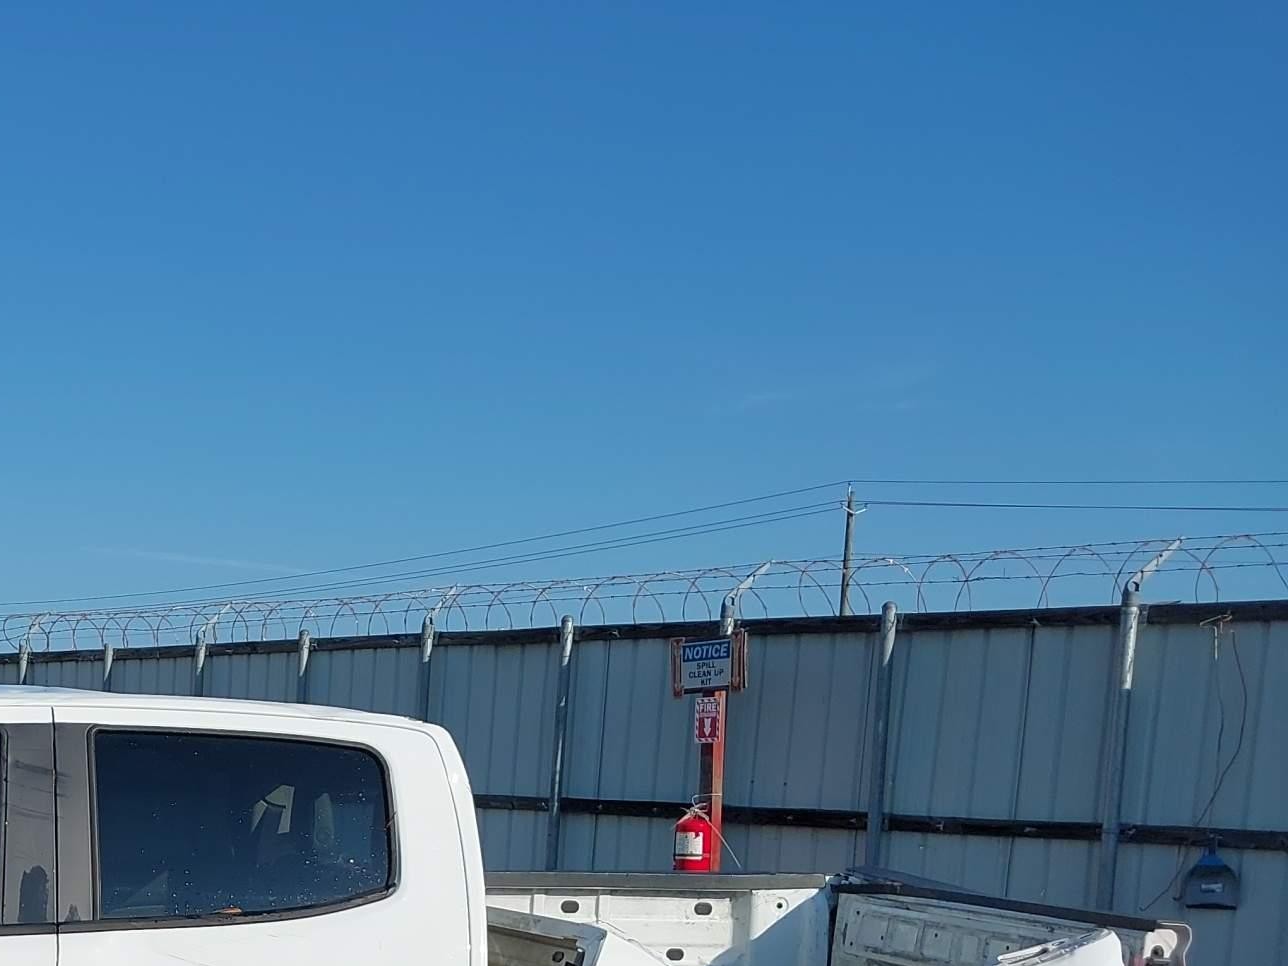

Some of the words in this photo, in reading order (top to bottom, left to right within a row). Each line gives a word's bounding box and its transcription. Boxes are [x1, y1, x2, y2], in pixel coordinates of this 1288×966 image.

[685, 644, 728, 660] NOTICE
[696, 662, 716, 670] SPILL
[689, 671, 712, 679] CLEAN
[714, 669, 725, 677] UP
[700, 678, 712, 686] KIT
[699, 703, 717, 713] FIRE
